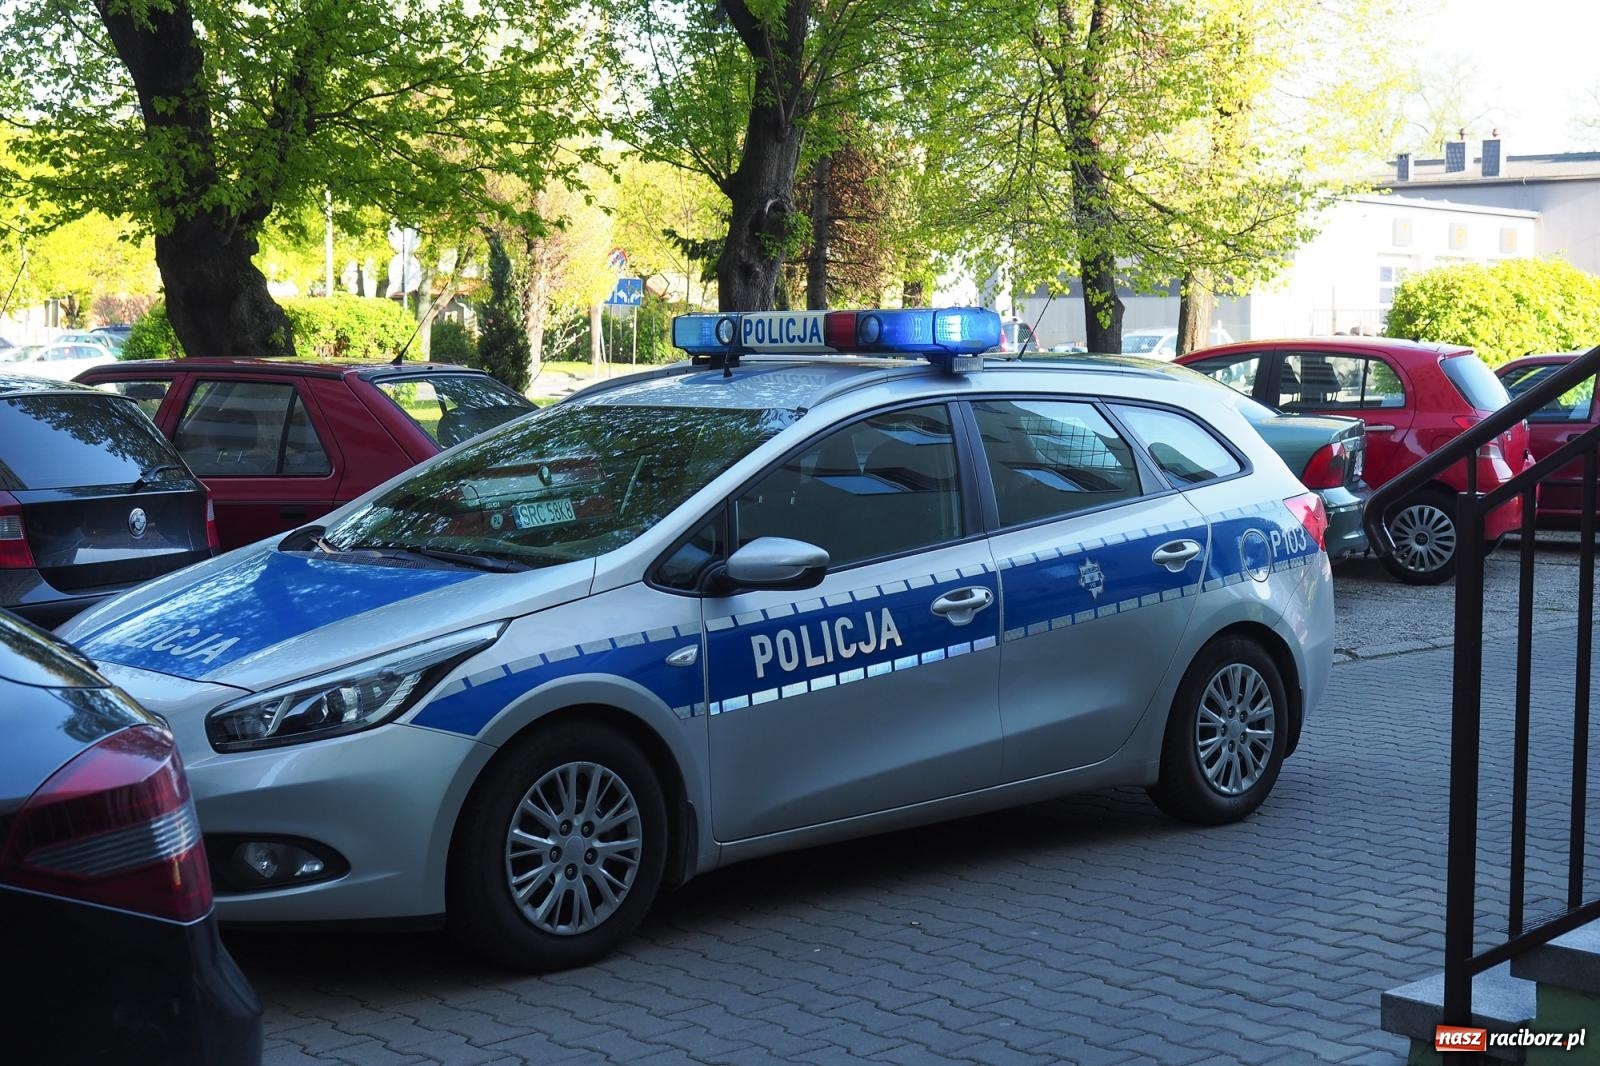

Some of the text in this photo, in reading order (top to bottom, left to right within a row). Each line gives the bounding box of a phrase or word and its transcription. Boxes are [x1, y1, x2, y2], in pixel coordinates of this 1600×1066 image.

[743, 318, 822, 344] POLICJA
[519, 501, 574, 526] SRC 58K8
[750, 607, 903, 679] POLICJA
